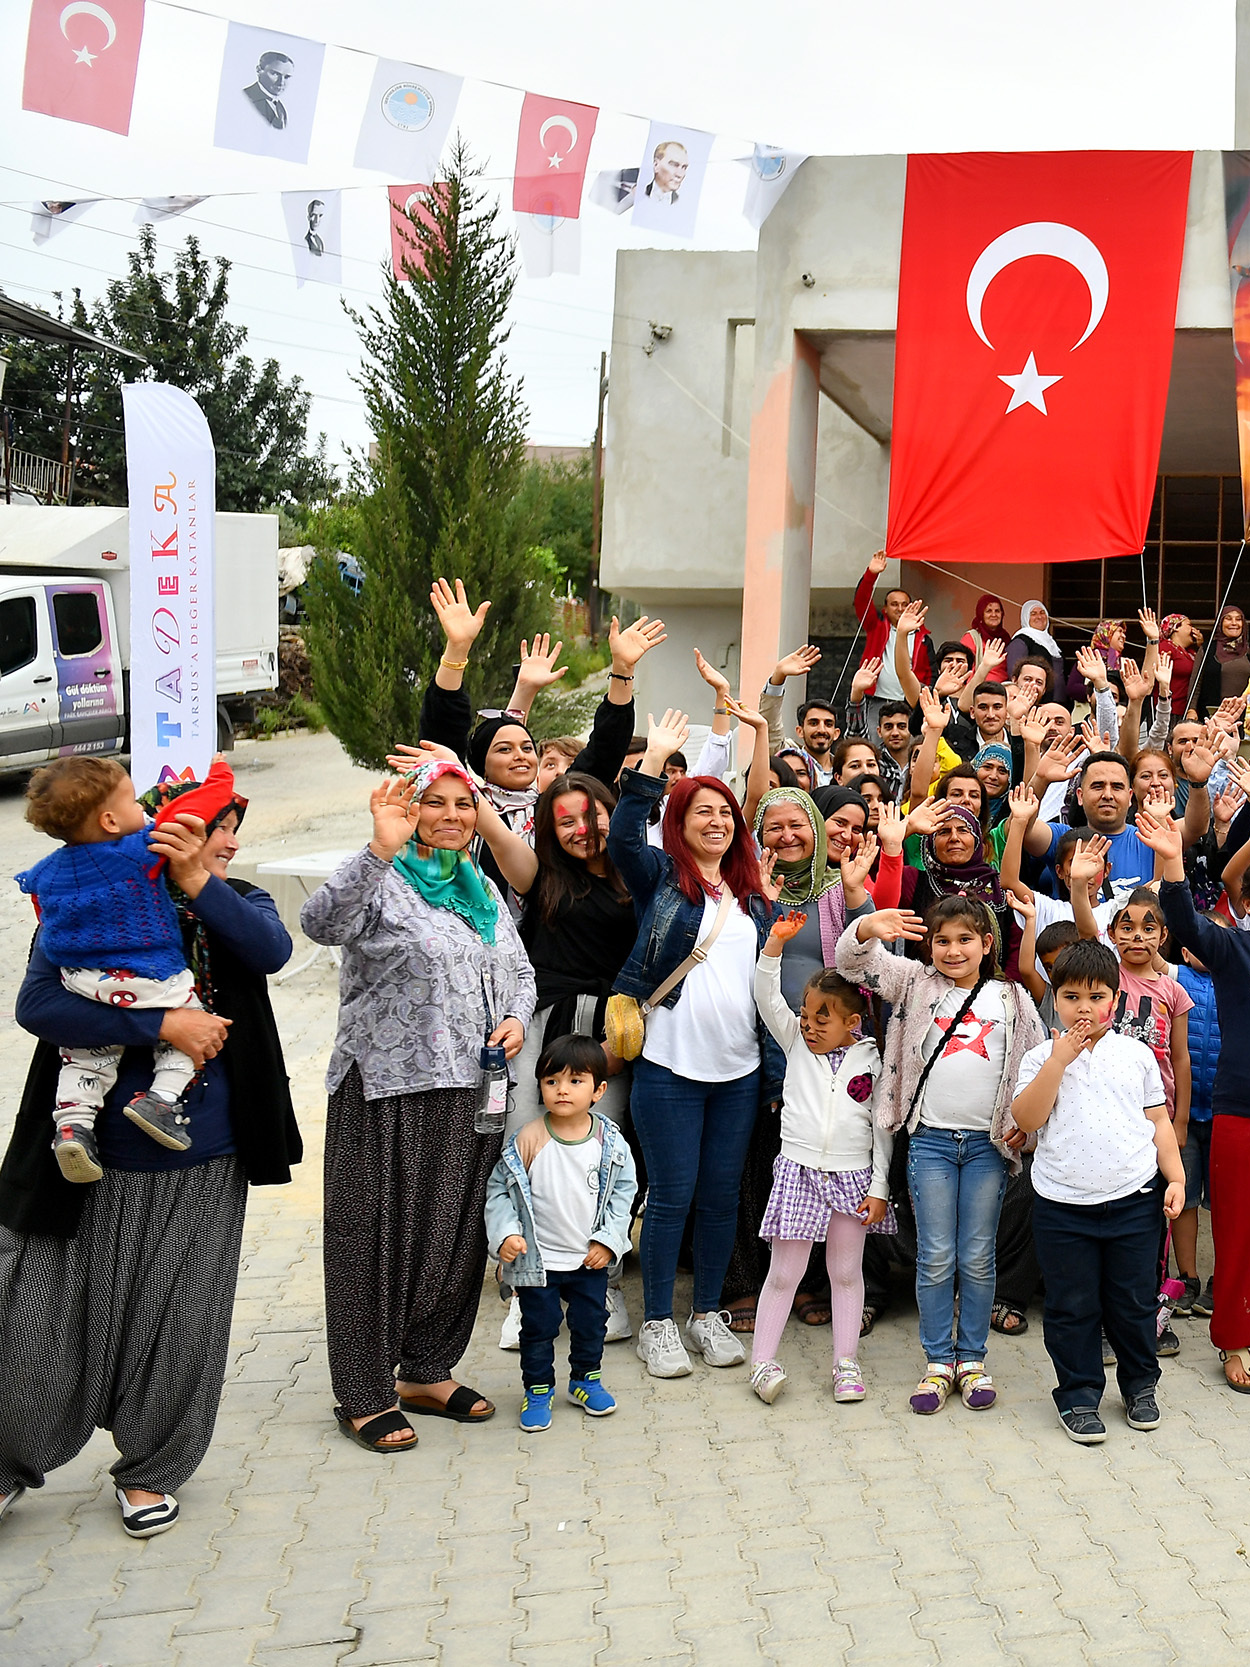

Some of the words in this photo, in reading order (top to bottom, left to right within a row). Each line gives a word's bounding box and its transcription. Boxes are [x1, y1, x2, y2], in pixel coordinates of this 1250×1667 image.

[187, 479, 198, 577] KATANLAR
[65, 684, 80, 696] Gül
[79, 682, 108, 694] döktüm
